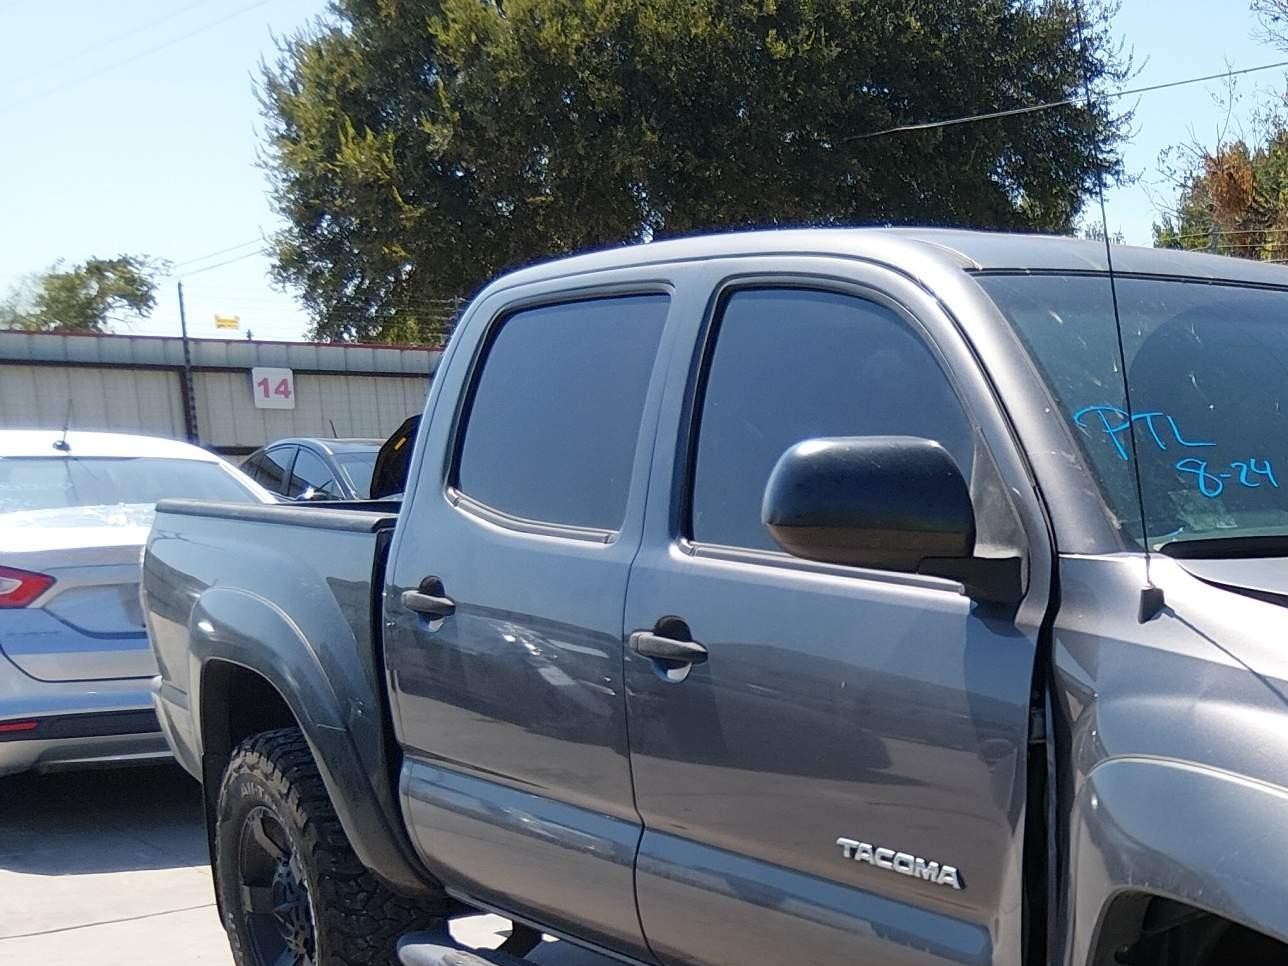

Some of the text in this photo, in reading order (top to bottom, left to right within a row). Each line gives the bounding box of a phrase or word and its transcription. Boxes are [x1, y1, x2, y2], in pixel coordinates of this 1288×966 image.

[257, 377, 292, 399] 14
[1073, 406, 1217, 460] PTL
[1176, 457, 1280, 497] 8-24
[836, 837, 964, 890] TACOMA
